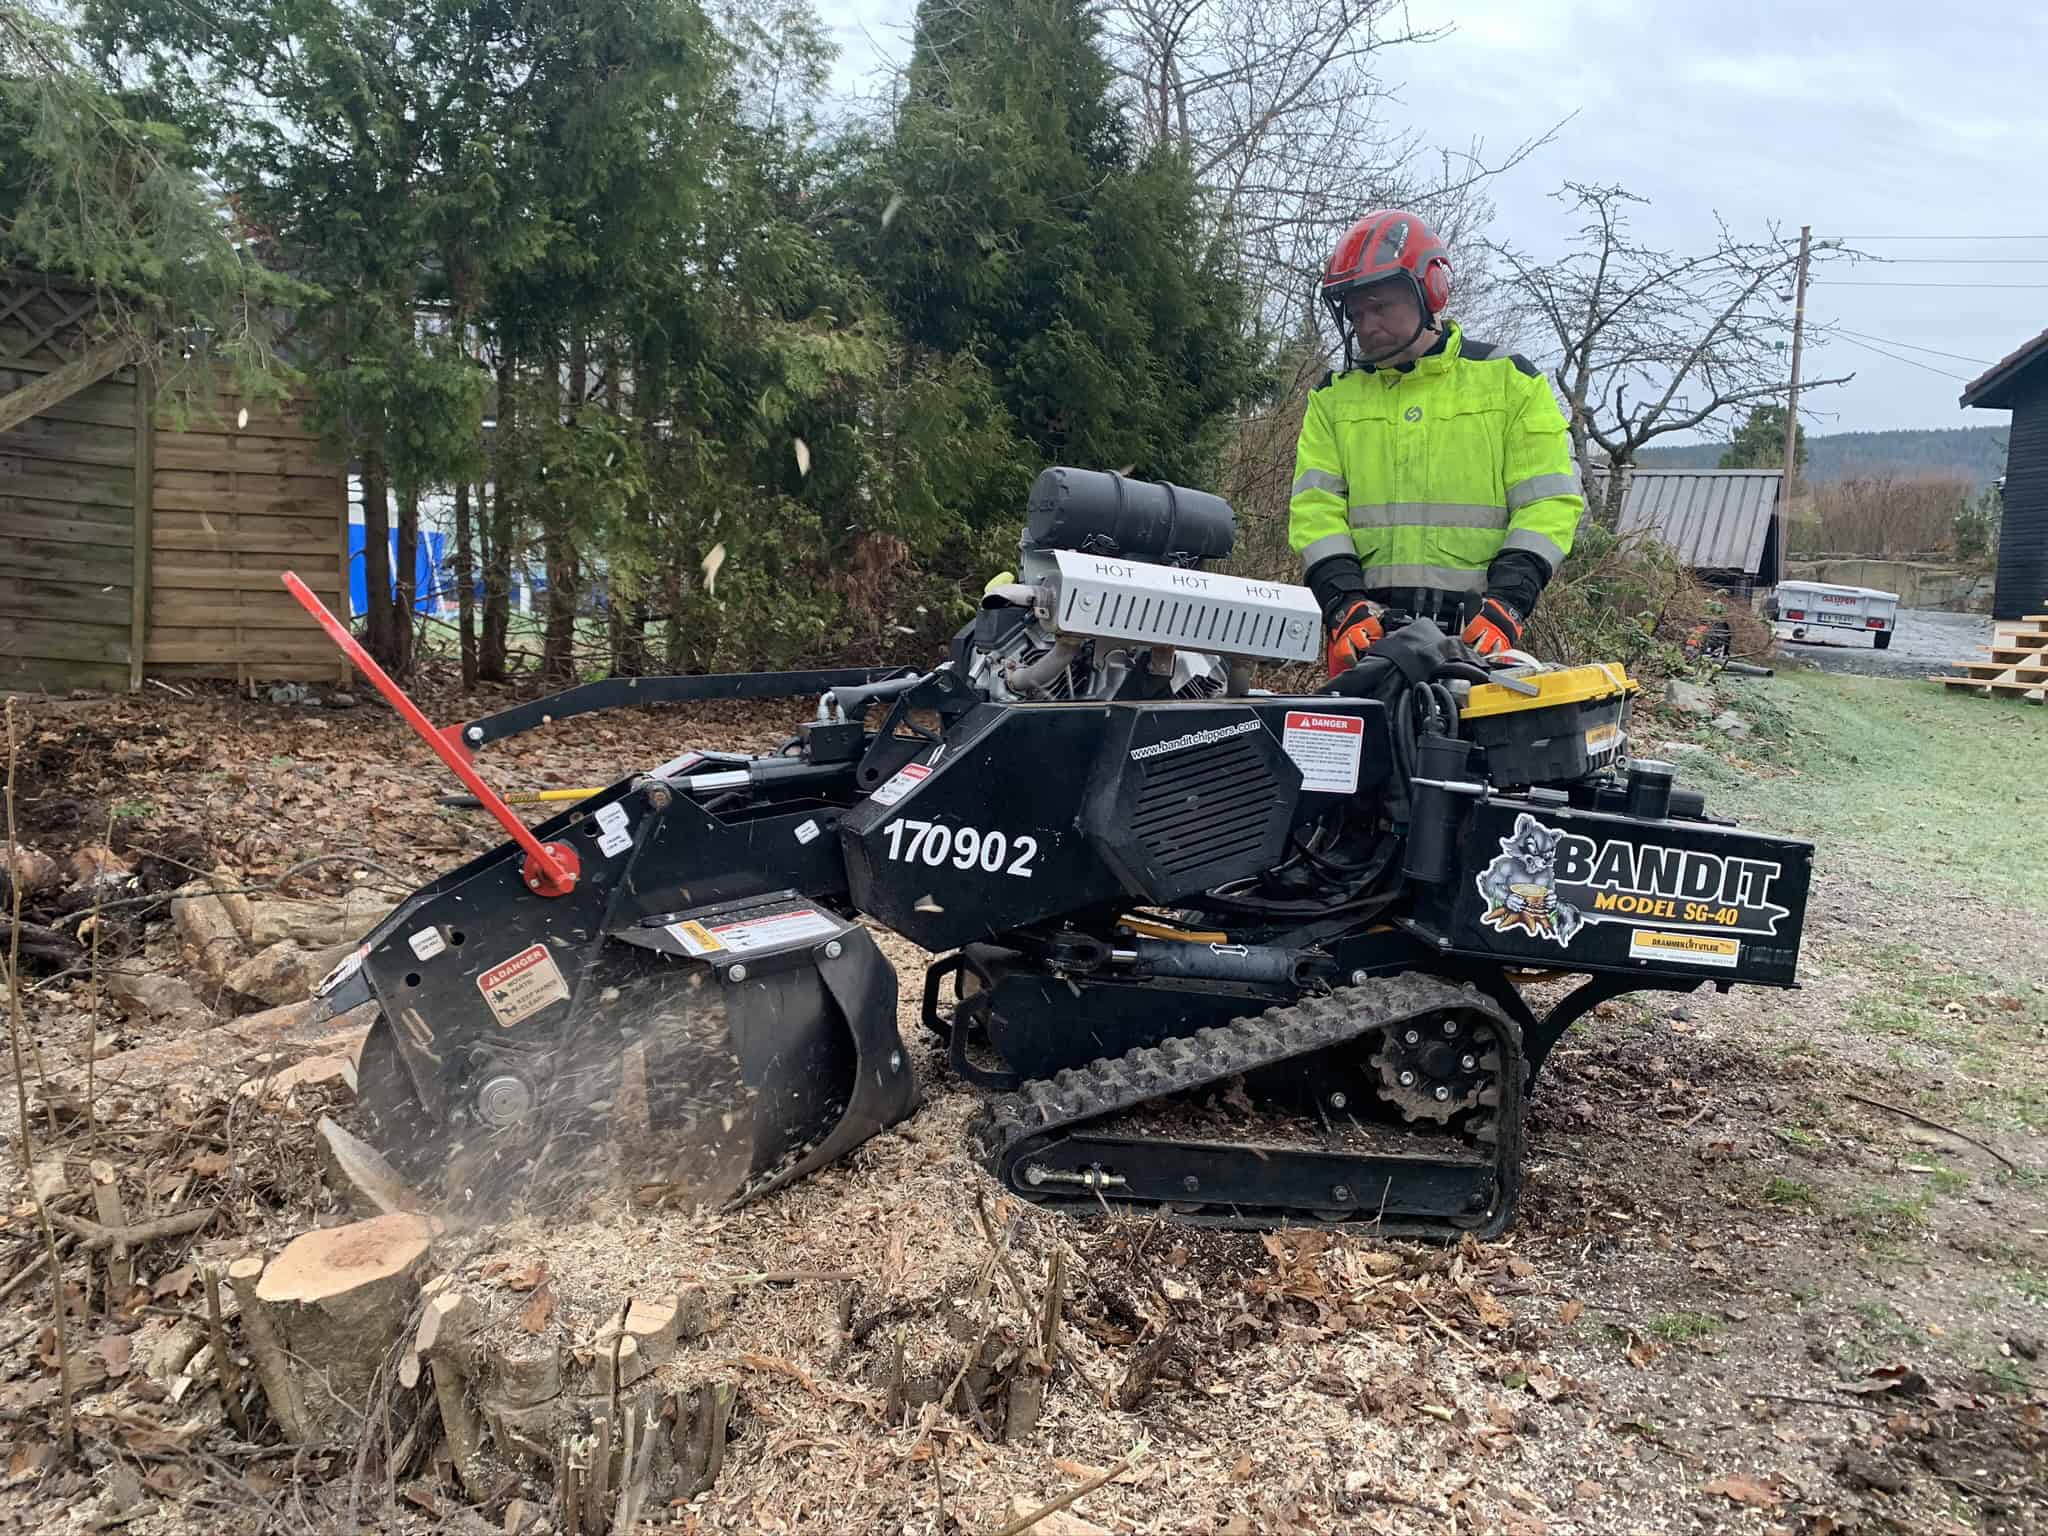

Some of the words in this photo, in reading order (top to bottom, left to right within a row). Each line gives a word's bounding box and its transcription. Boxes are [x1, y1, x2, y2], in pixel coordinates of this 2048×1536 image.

[1096, 562, 1136, 579] HOT
[1171, 574, 1209, 591] HOT
[1246, 584, 1282, 601] HOT
[1130, 719, 1261, 760] www.banditchippers.com
[1311, 718, 1348, 729] DANGER
[883, 818, 1038, 878] 170902
[1553, 833, 1781, 907] BANDIT
[1594, 891, 1677, 919] MODEL
[1683, 903, 1739, 926] SG-40
[497, 950, 543, 979] DANGER
